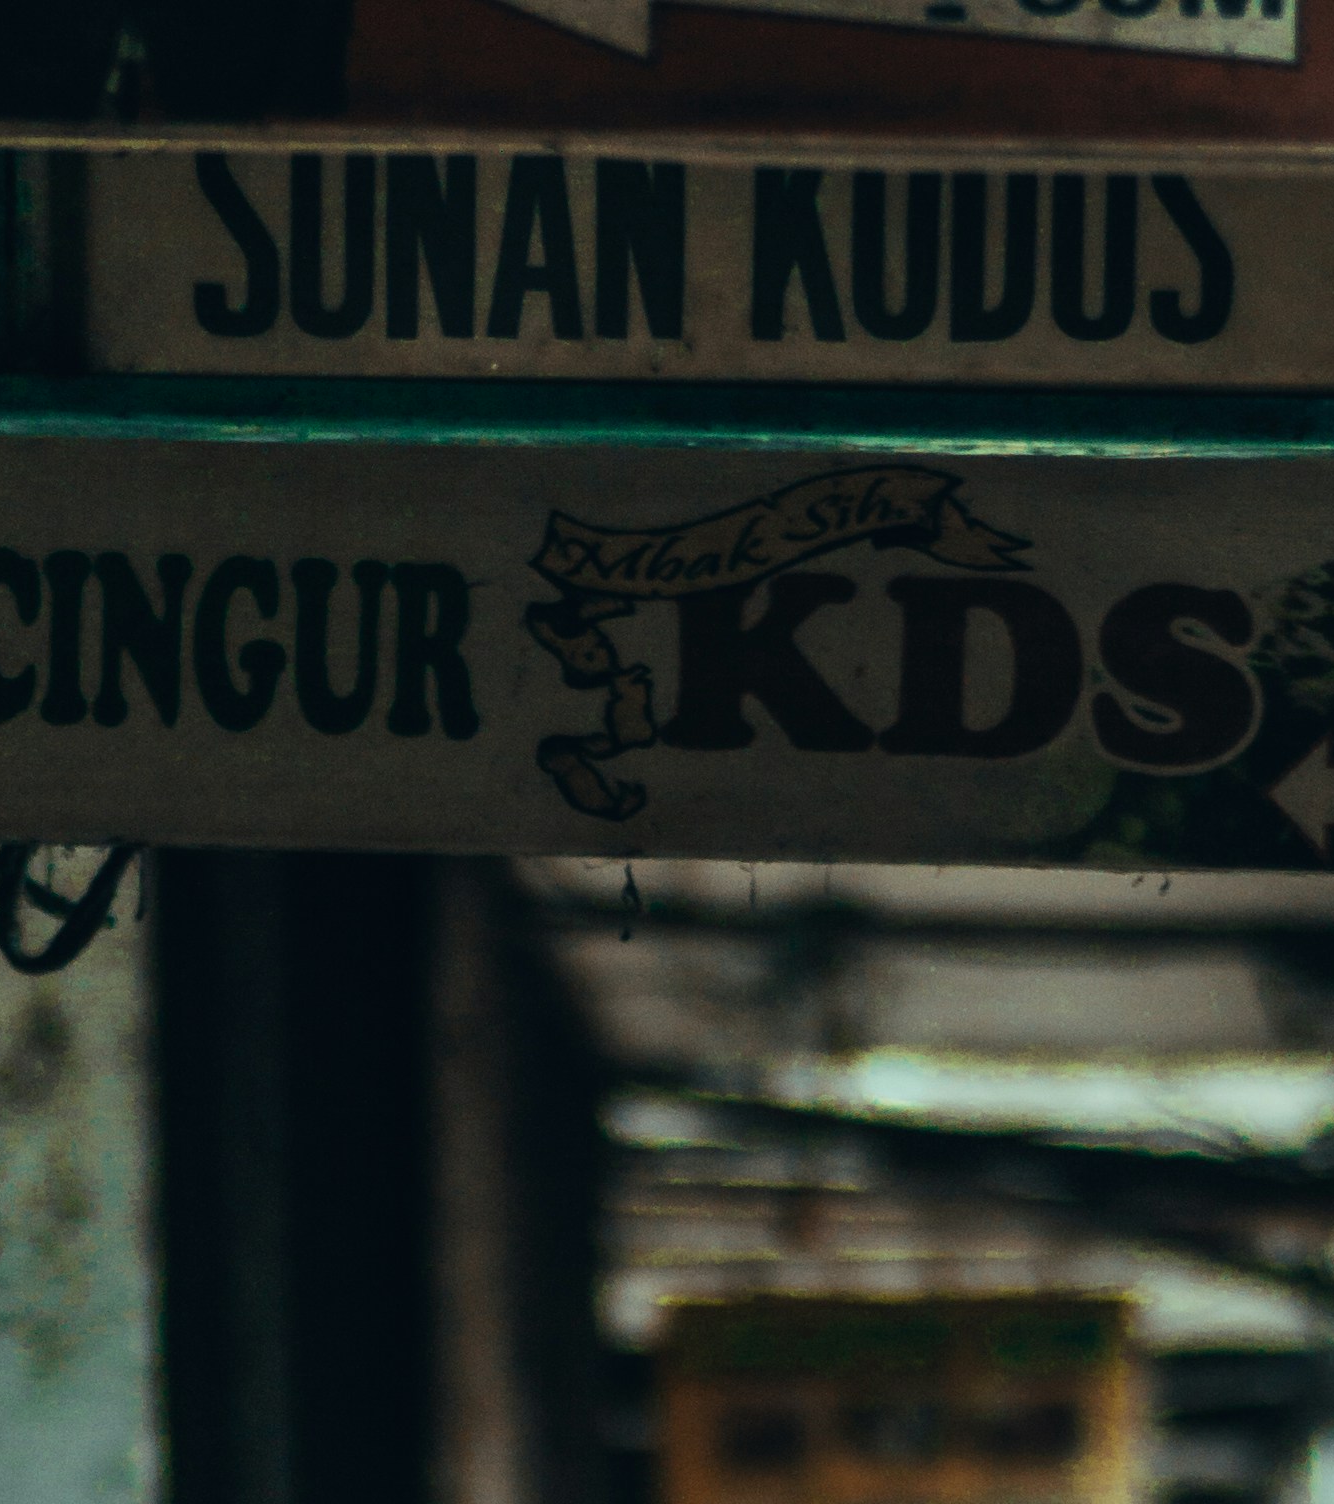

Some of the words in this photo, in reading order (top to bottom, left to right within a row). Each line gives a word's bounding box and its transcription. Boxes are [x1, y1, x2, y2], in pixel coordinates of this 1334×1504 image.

[193, 153, 685, 341] SUNAN
[751, 167, 1234, 344] KUDUS
[555, 516, 772, 583] Mbak
[660, 571, 1261, 774] KDS
